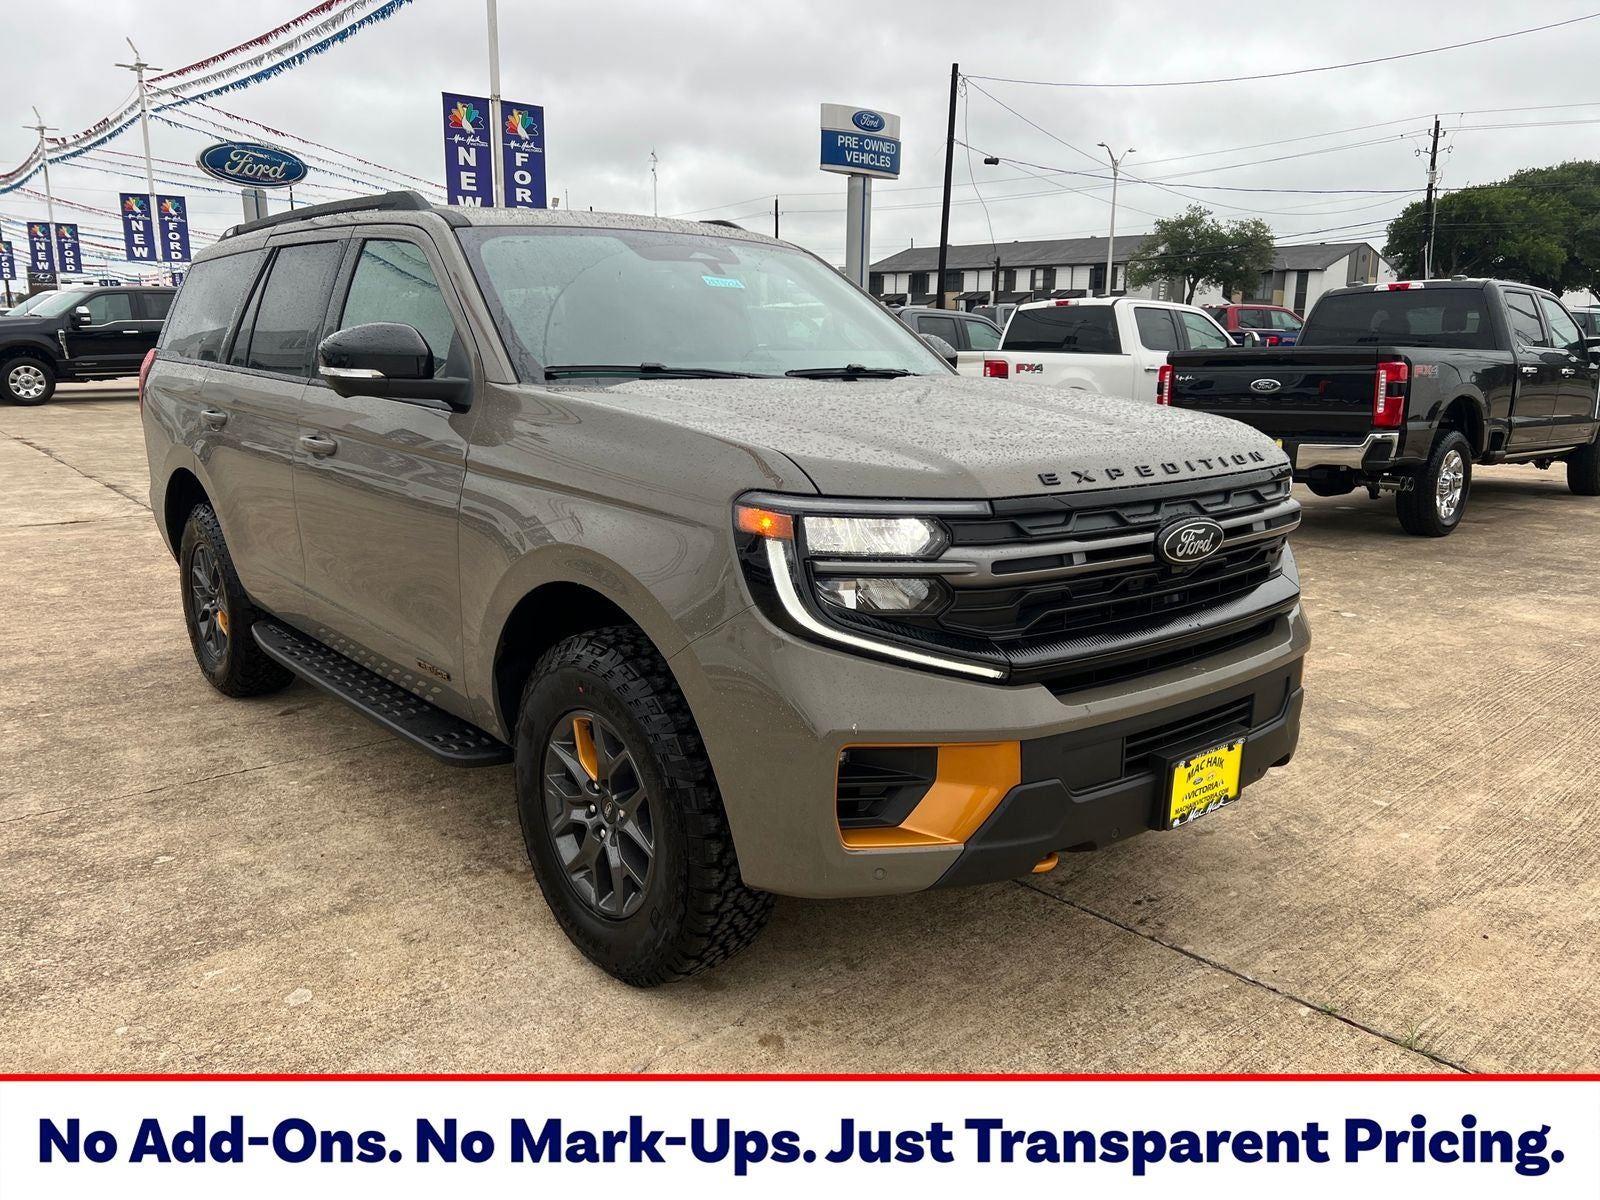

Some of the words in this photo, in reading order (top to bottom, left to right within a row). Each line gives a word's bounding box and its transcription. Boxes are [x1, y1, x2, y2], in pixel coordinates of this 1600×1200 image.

[860, 113, 880, 128] Ford
[837, 135, 896, 155] PRE-OWNED
[845, 150, 891, 168] VEHICLES
[224, 149, 286, 179] Ford
[457, 146, 482, 207] NEW
[513, 152, 533, 209] FOR
[131, 220, 148, 258] NEW
[168, 222, 182, 260] FORD
[1, 256, 11, 279] FORD
[35, 242, 49, 270] NEW
[64, 243, 76, 272] FORD
[1016, 363, 1043, 374] FX4
[1414, 364, 1438, 378] FX4
[1257, 381, 1274, 389] Ford
[1038, 450, 1265, 486] EXPEDITION
[1177, 528, 1216, 557] Ford
[1186, 760, 1206, 783] MAC
